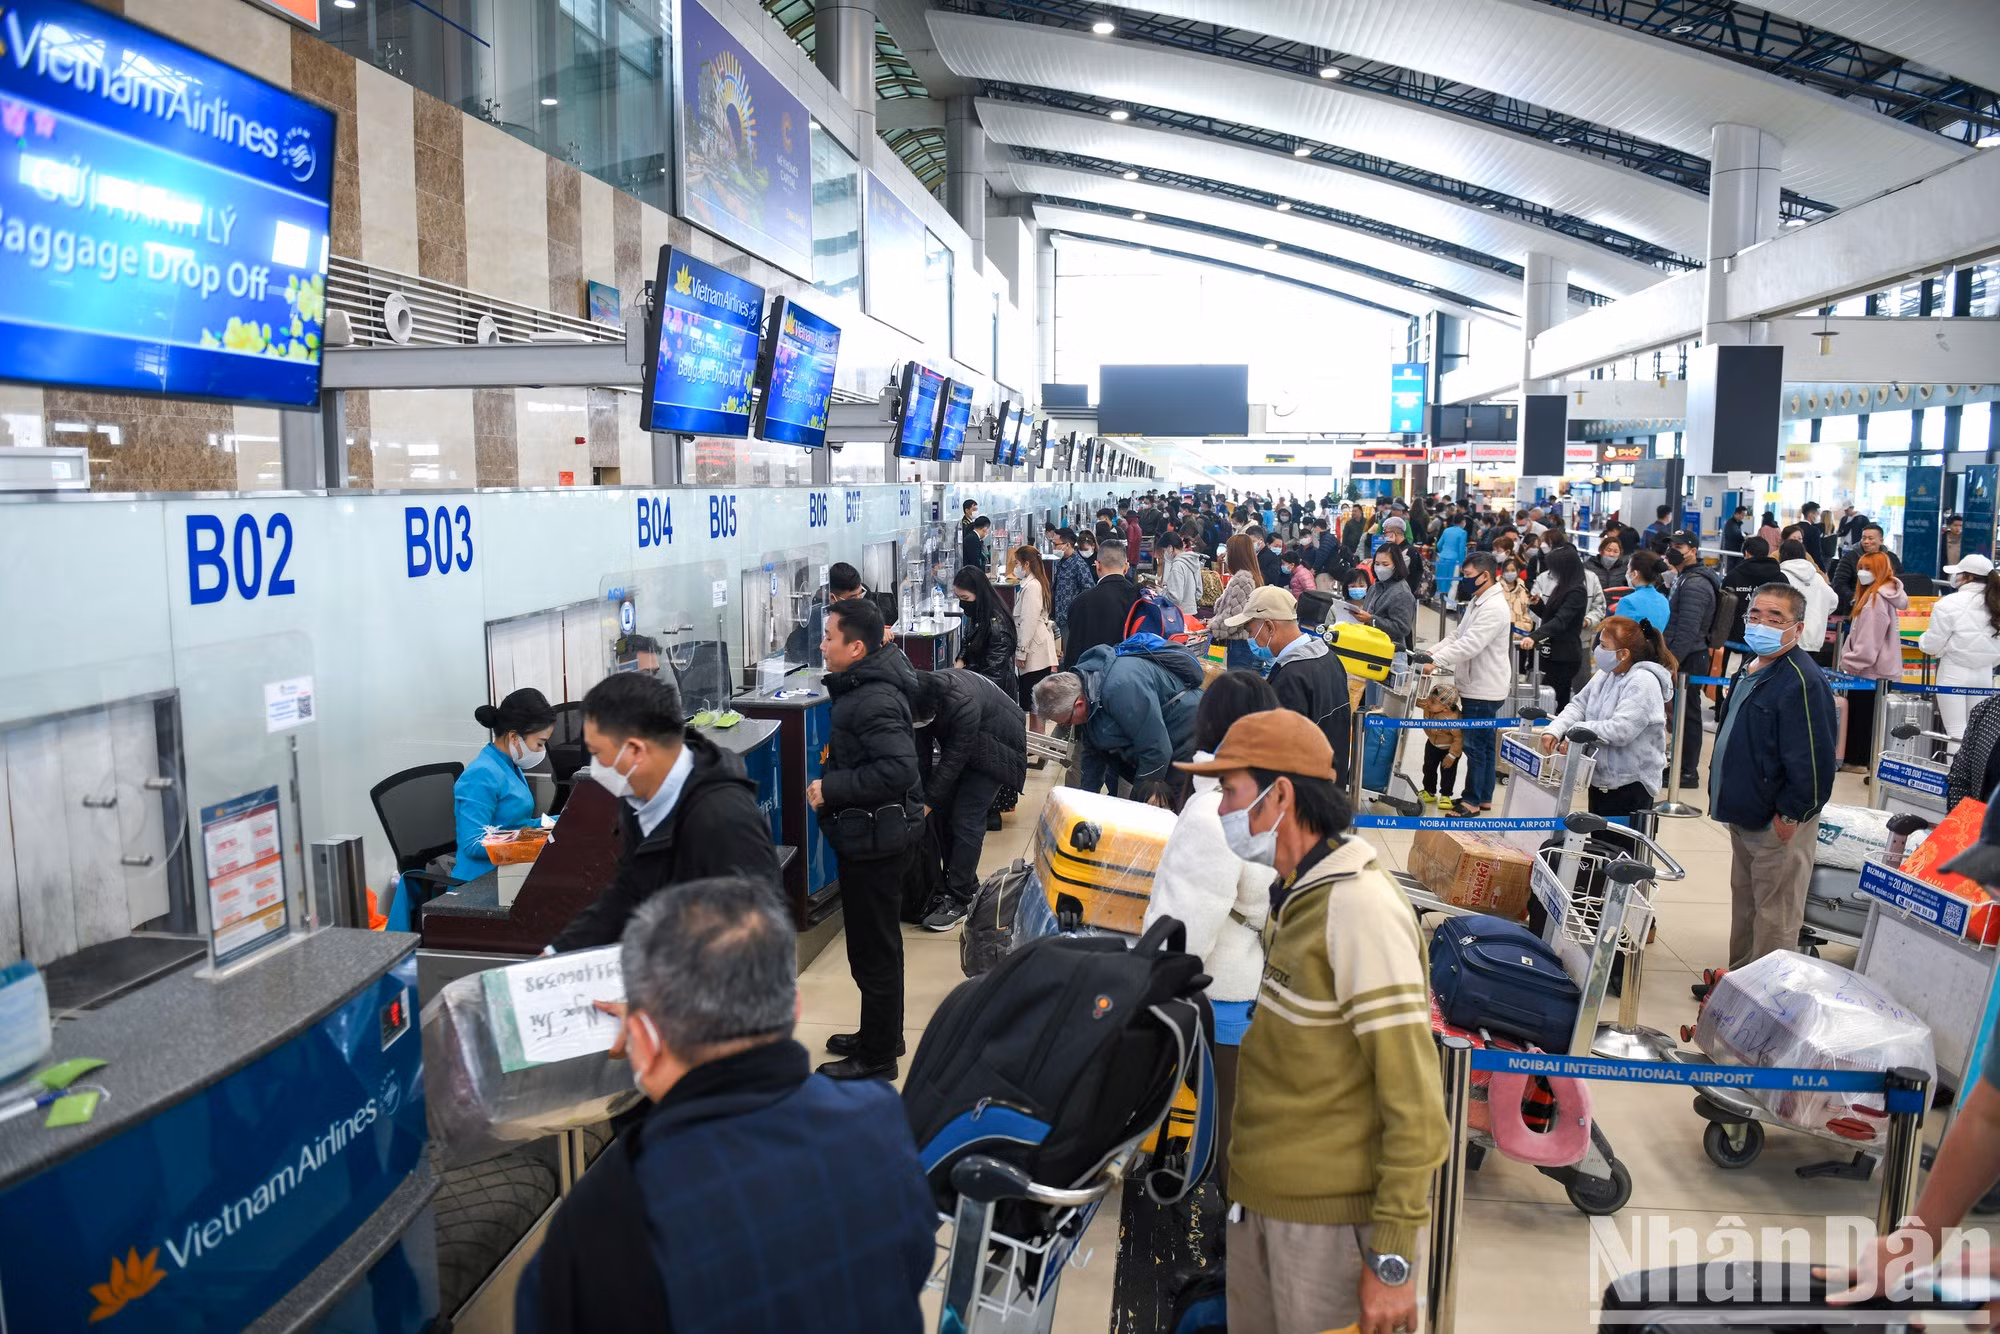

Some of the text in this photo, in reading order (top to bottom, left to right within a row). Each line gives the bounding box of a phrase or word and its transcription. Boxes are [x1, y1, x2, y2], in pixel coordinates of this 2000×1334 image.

[0, 205, 138, 281] aggage
[147, 243, 221, 299] Drop
[227, 262, 269, 301] Off
[677, 357, 711, 386] Baggage
[729, 369, 742, 387] Off
[1476, 448, 1505, 456] LUCKY
[710, 494, 736, 538] B05
[810, 492, 827, 527] B06
[846, 490, 860, 523] B07
[900, 489, 910, 516] B08
[637, 496, 673, 548] B04
[404, 504, 473, 578] B03
[186, 512, 295, 605] B02
[607, 587, 625, 601] ACV
[1376, 818, 1397, 826] N.I.A
[1866, 866, 1887, 880] BIZMAN
[1892, 878, 1914, 896] 20.000
[1925, 876, 1944, 888] HAPPY
[1508, 1057, 1829, 1087] NOIBAI INTERNATIONAL AIRPORT N.I.A
